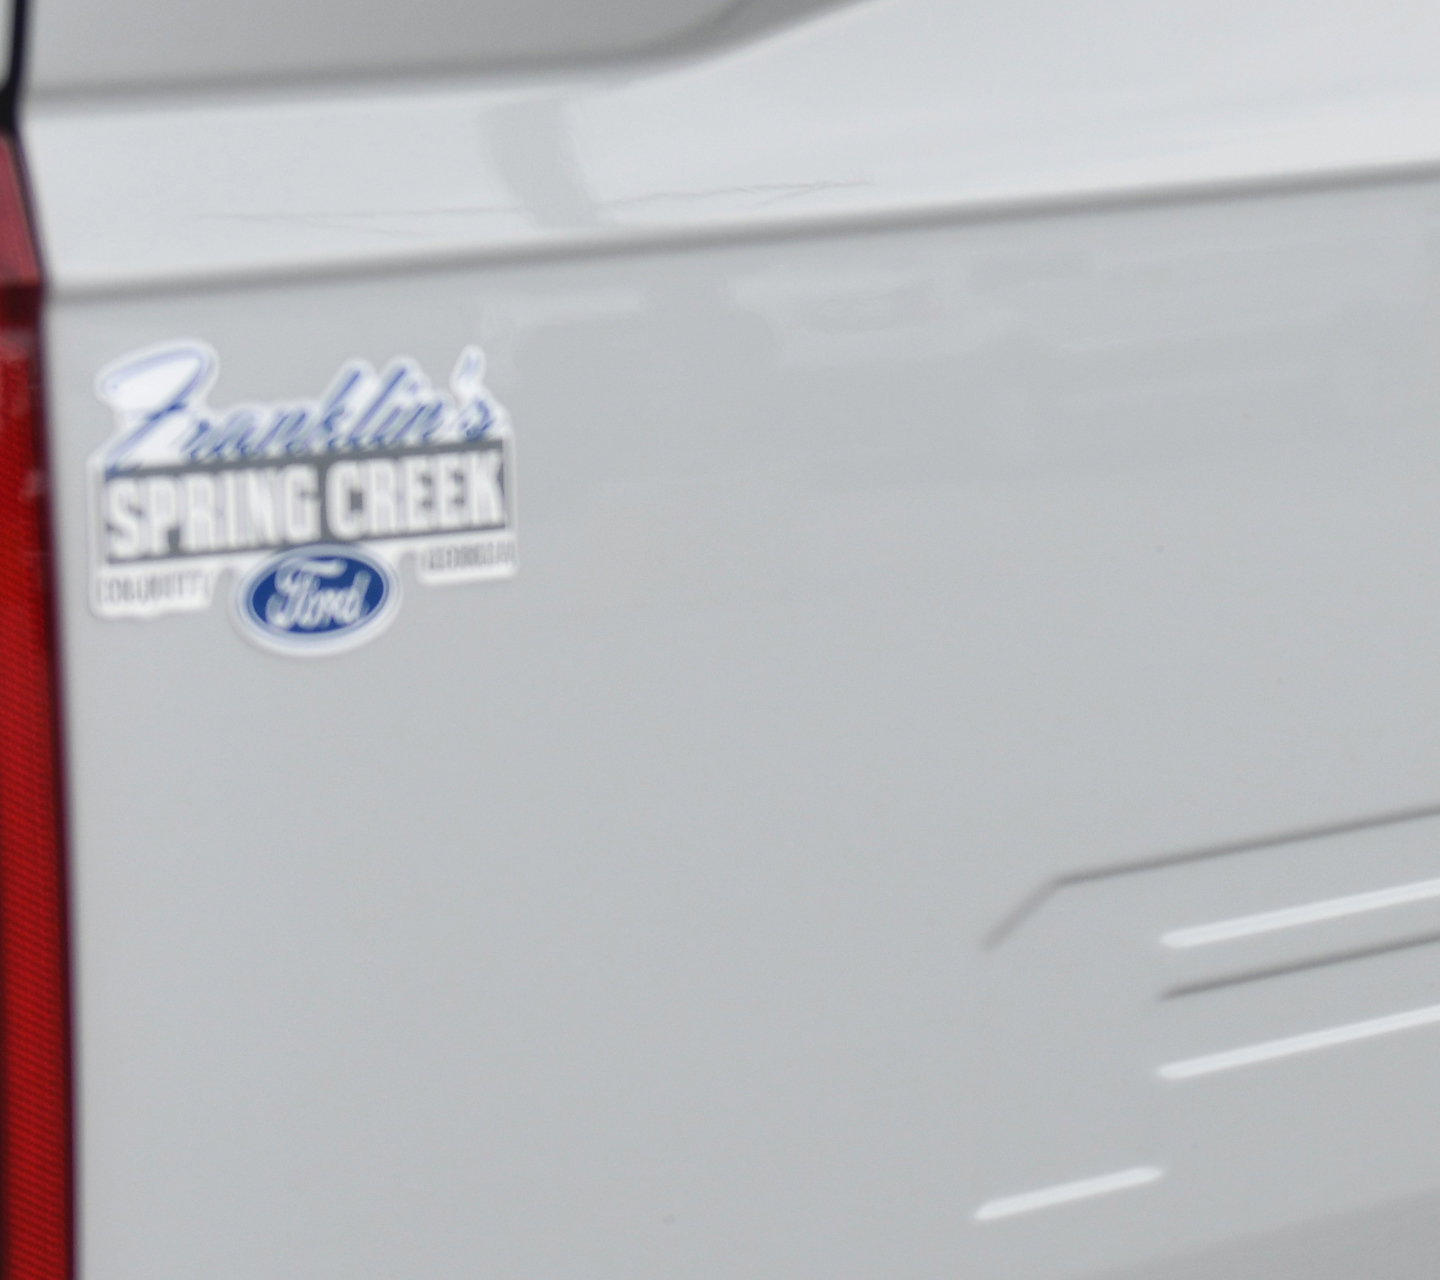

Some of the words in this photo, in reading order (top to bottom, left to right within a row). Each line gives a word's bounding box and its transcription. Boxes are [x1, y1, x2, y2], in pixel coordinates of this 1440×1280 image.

[98, 346, 496, 477] Franklin's
[107, 464, 320, 562] SPRING
[326, 447, 503, 542] CREEK
[264, 554, 374, 630] Ford
